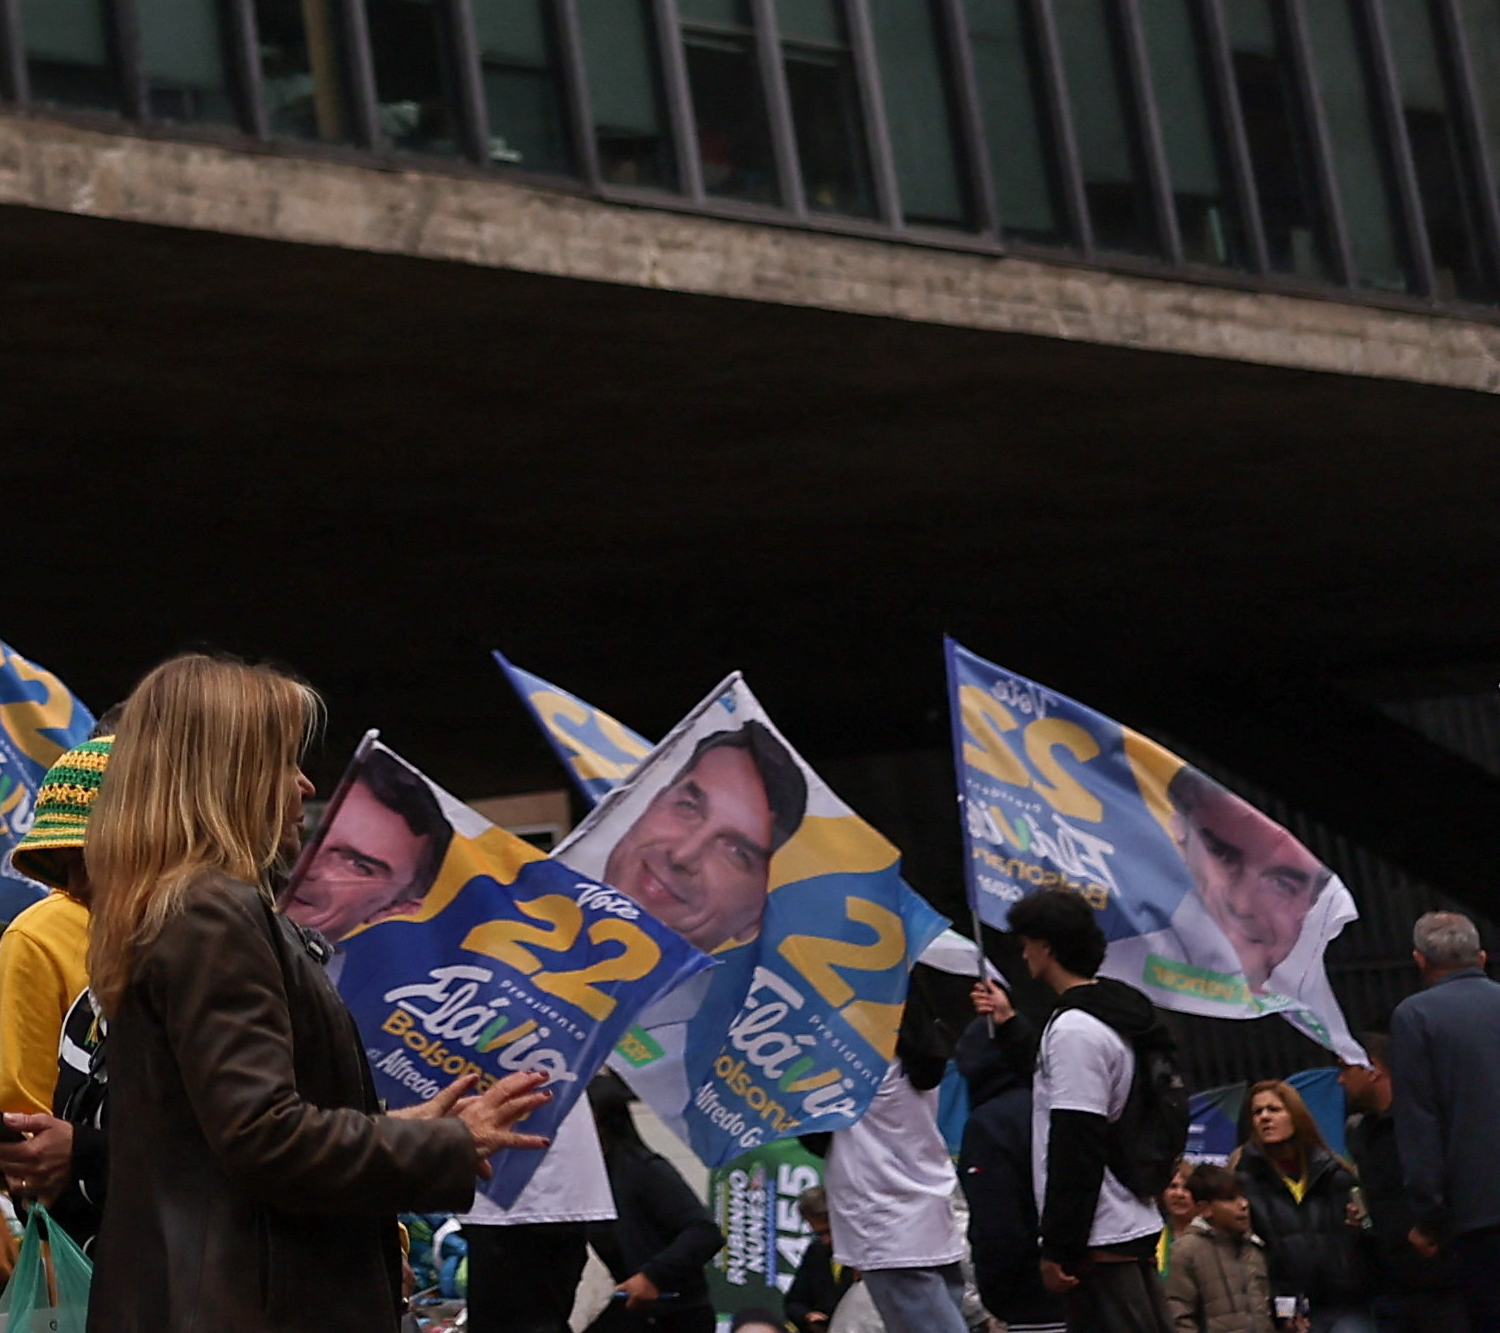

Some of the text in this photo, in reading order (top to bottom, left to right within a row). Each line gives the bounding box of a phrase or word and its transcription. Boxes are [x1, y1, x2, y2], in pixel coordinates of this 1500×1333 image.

[574, 882, 641, 920] Vote
[460, 893, 662, 1021] 22
[383, 965, 578, 1085] Flávio
[500, 979, 586, 1040] Presidente
[375, 1048, 440, 1099] Alfredo
[809, 1014, 879, 1085] President
[726, 1169, 749, 1285] RUBINHO
[746, 1189, 766, 1273] NUNES
